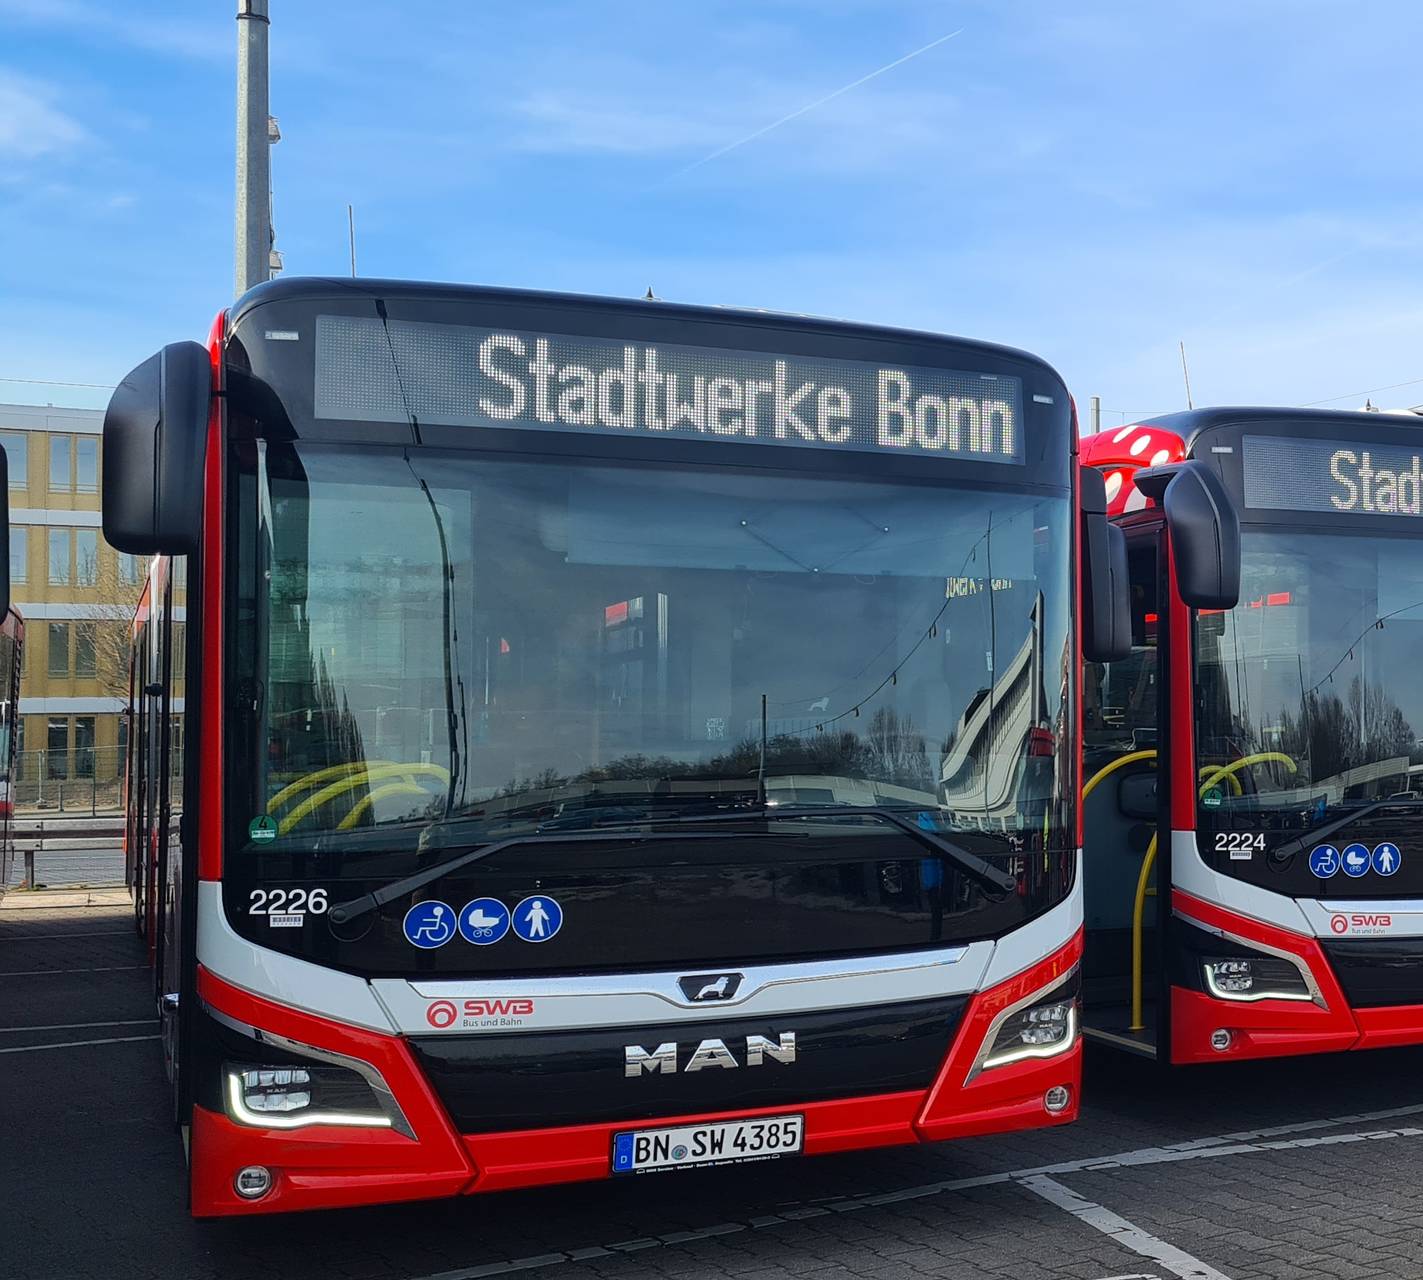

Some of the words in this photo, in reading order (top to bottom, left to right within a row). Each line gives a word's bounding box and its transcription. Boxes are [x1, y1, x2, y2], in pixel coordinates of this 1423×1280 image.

[479, 334, 850, 442] Stadtwerke
[878, 369, 1014, 454] Bonn
[258, 816, 267, 829] 4
[1214, 833, 1266, 851] 2224
[248, 888, 328, 915] 2226
[1351, 915, 1392, 926] SWB
[463, 999, 534, 1016] SWB
[463, 1019, 479, 1027] Bus
[480, 1018, 498, 1027] und
[500, 1017, 522, 1026] Bahn
[625, 1032, 796, 1078] MAN
[634, 1133, 670, 1164] BN
[691, 1128, 726, 1157] SW
[732, 1121, 798, 1153] 4385
[620, 1155, 628, 1164] D
